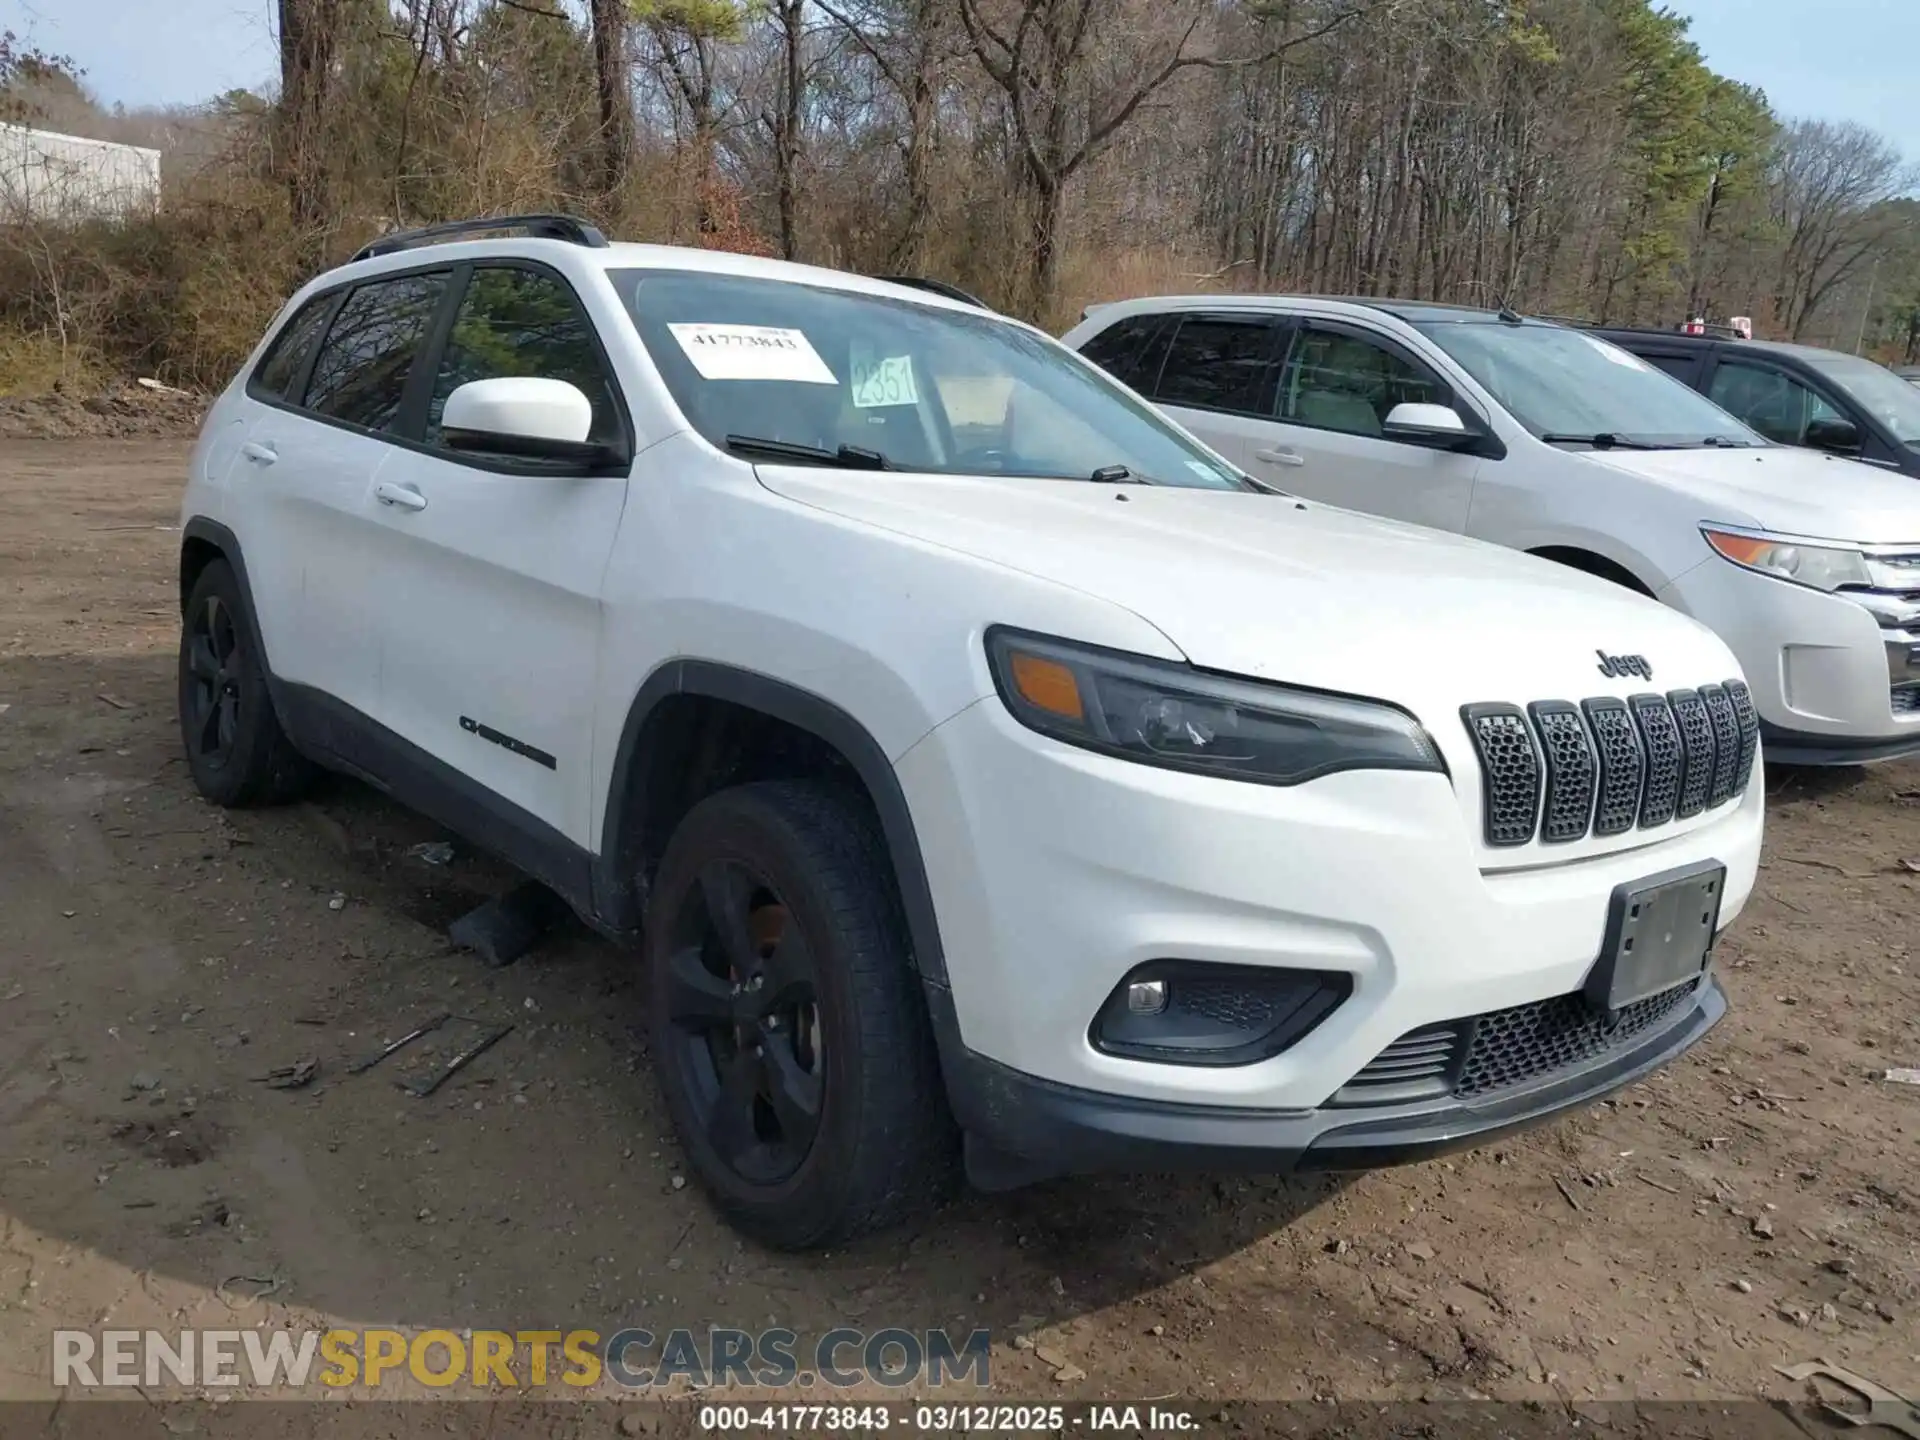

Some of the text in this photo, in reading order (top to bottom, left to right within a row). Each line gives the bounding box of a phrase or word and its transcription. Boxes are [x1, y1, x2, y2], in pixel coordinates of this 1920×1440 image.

[693, 334, 798, 350] 41773843
[854, 360, 915, 404] 2351
[1595, 649, 1653, 681] Jeep
